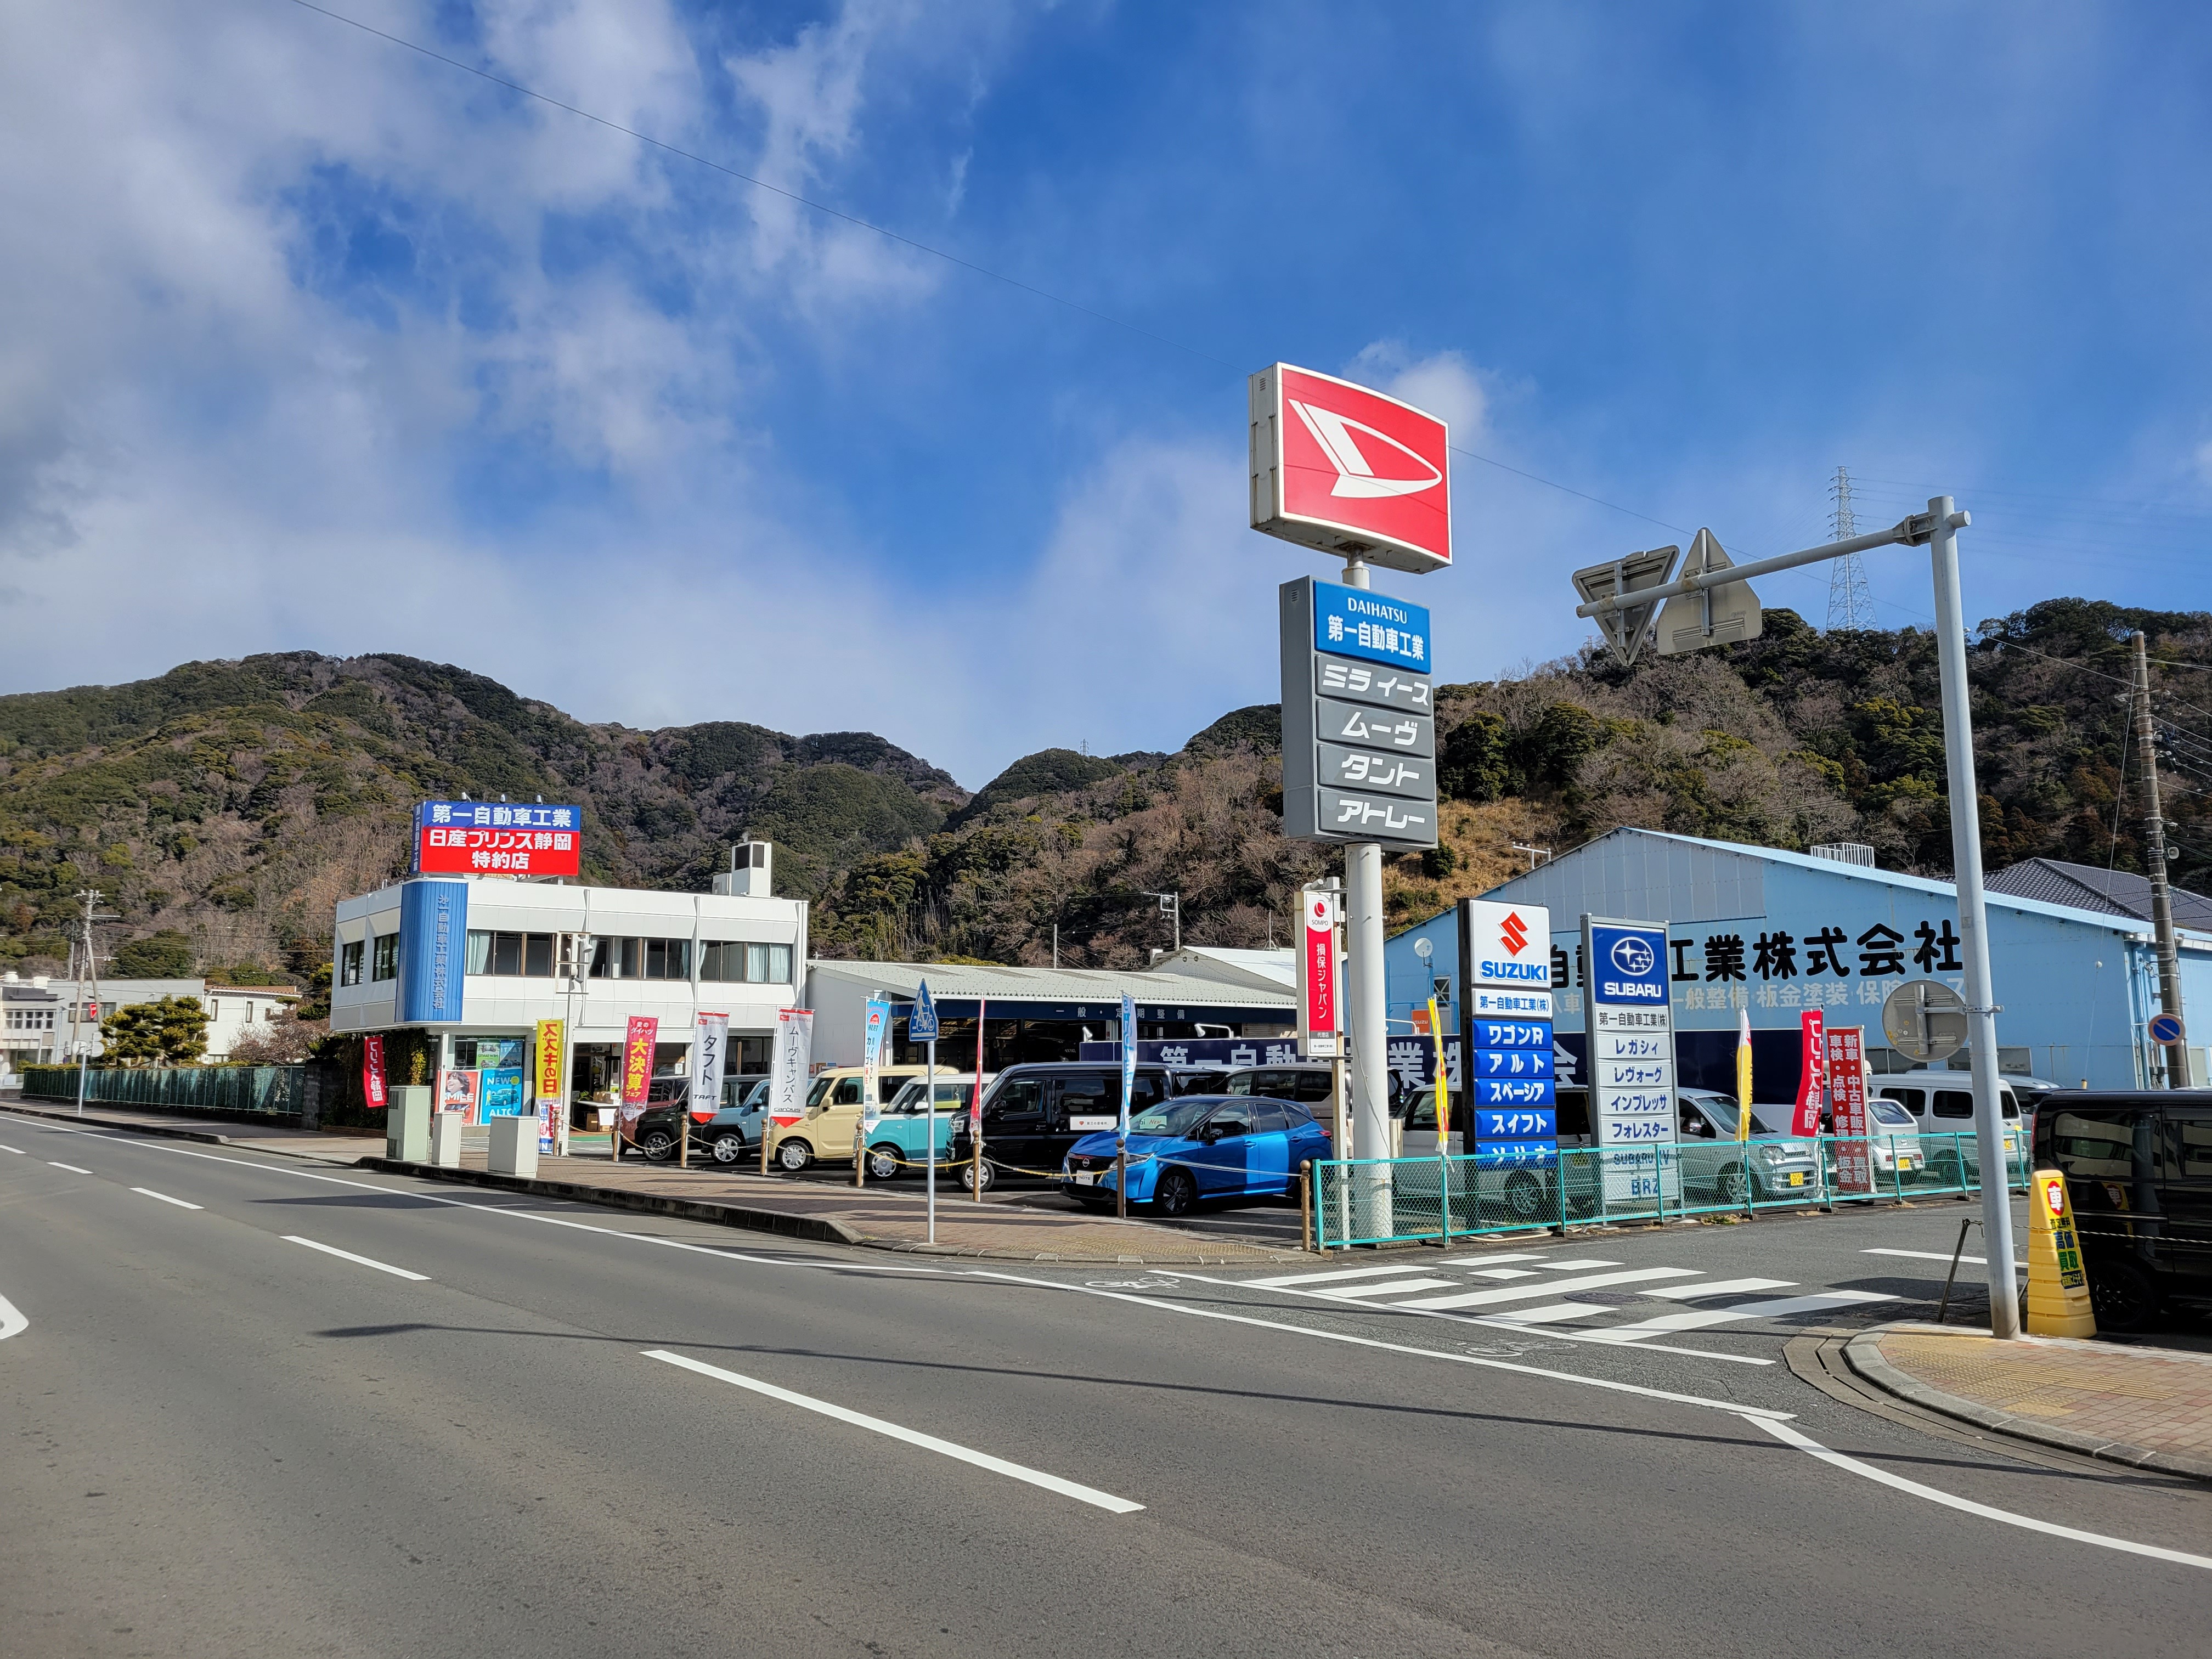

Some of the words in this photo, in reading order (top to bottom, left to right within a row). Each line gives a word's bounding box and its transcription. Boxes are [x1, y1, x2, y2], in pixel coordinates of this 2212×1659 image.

[1347, 596, 1408, 625] DAIHATSU
[1328, 614, 1425, 661] 第一自動車工業
[1341, 712, 1418, 746] ムーヴ
[1341, 754, 1420, 787] タント
[432, 804, 572, 828] 第一自動車工業
[1338, 799, 1425, 830] アトレー
[430, 829, 572, 851] 日産プリンス静岡
[471, 851, 531, 870] 特約店
[1316, 943, 1328, 1019] 損保ジャパン
[1480, 960, 1548, 981] SUZUKI
[1604, 981, 1662, 998] SUBARU
[1756, 980, 1849, 1008] 板金塗装
[1480, 995, 1549, 1012] 第一自動車工業(株)
[630, 1026, 653, 1035] ダイハツ
[1599, 1012, 1668, 1029] 第一自動車工業(株)
[1489, 1025, 1543, 1046] ワゴンR
[626, 1037, 649, 1091] 大決算
[702, 1035, 717, 1086] タフト
[783, 1026, 799, 1103] ムーヴキャンバス
[1489, 1053, 1545, 1074] アルト
[487, 1076, 510, 1086] NEW
[1614, 1066, 1662, 1084] レヴォーグ
[1490, 1082, 1545, 1103] スペーシア
[1611, 1094, 1667, 1111] インプレッサ
[489, 1108, 514, 1117] ALTO
[1491, 1114, 1547, 1135] スイフト
[1611, 1122, 1669, 1139] フォレスター
[2047, 1186, 2064, 1211] 車
